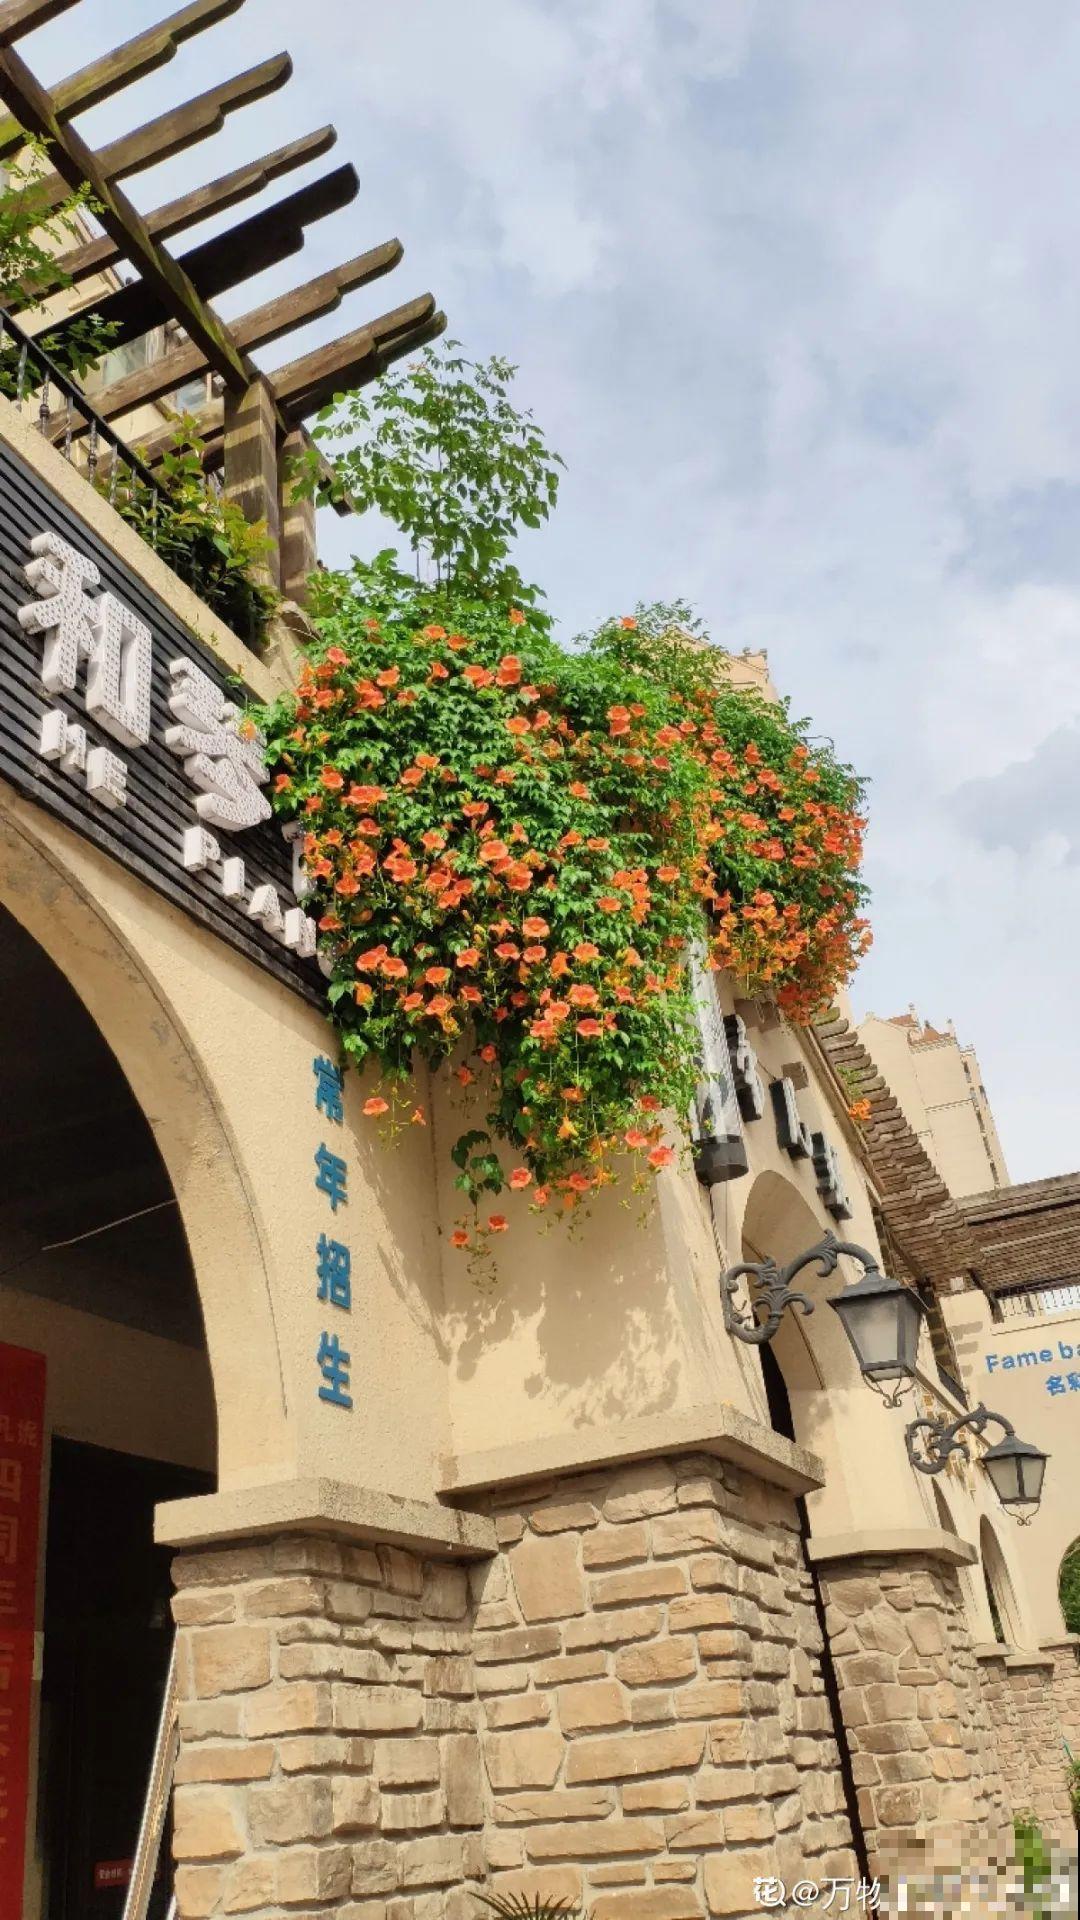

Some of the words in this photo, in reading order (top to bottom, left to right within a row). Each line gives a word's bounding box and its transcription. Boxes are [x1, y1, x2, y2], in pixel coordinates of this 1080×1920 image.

[17, 530, 317, 898] 和琴
[40, 709, 128, 810] HE
[183, 825, 334, 980] PIAN
[312, 1054, 353, 1409] 常年招生
[985, 1349, 1053, 1374] Fame
